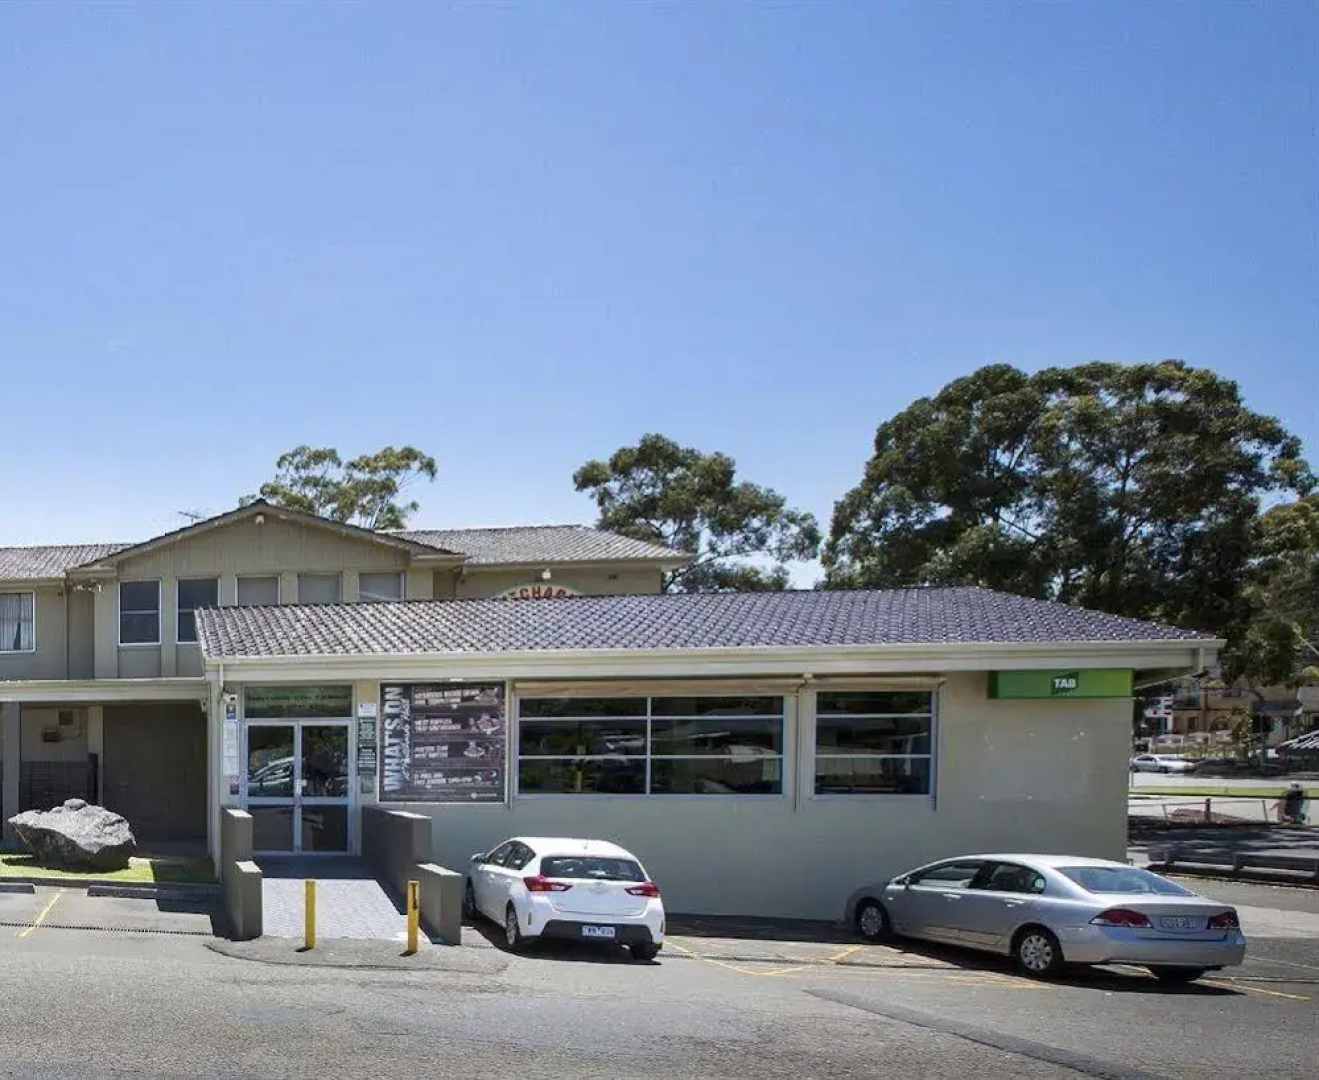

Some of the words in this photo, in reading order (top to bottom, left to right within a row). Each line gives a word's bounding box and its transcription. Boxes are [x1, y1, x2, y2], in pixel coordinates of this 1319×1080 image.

[1054, 678, 1077, 689] TAB
[383, 687, 402, 714] ON
[383, 717, 402, 791] WHAT'S
